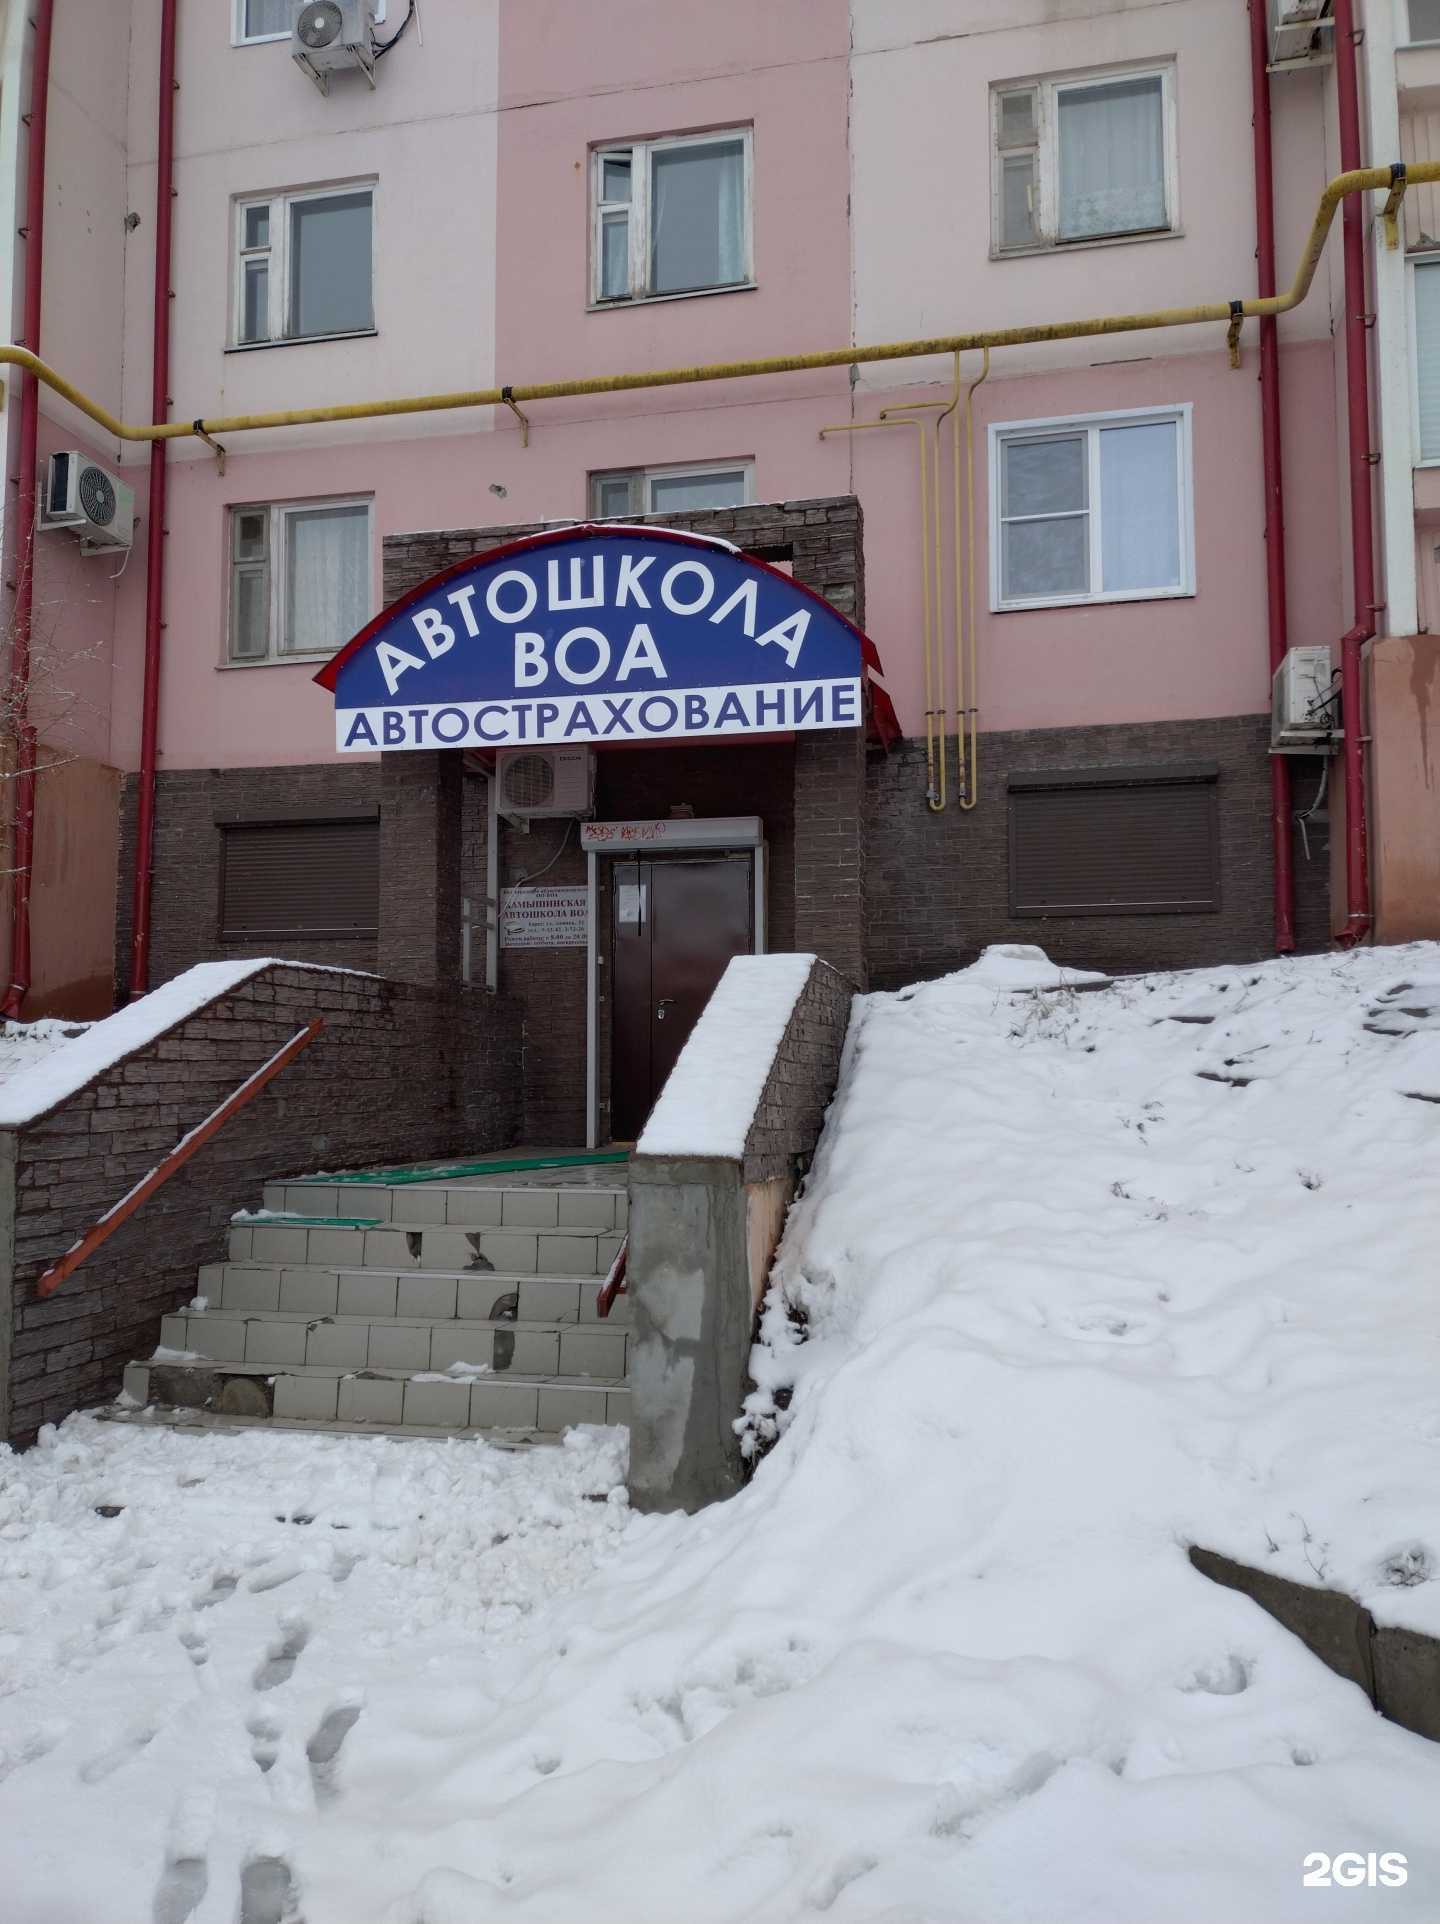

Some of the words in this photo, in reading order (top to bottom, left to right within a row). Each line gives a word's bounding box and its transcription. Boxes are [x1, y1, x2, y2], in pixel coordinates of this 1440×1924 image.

[374, 554, 812, 696] АВТОШКОЛА
[514, 623, 668, 688] ВОА
[343, 683, 856, 747] АВТОСТРАХОВАНИЕ
